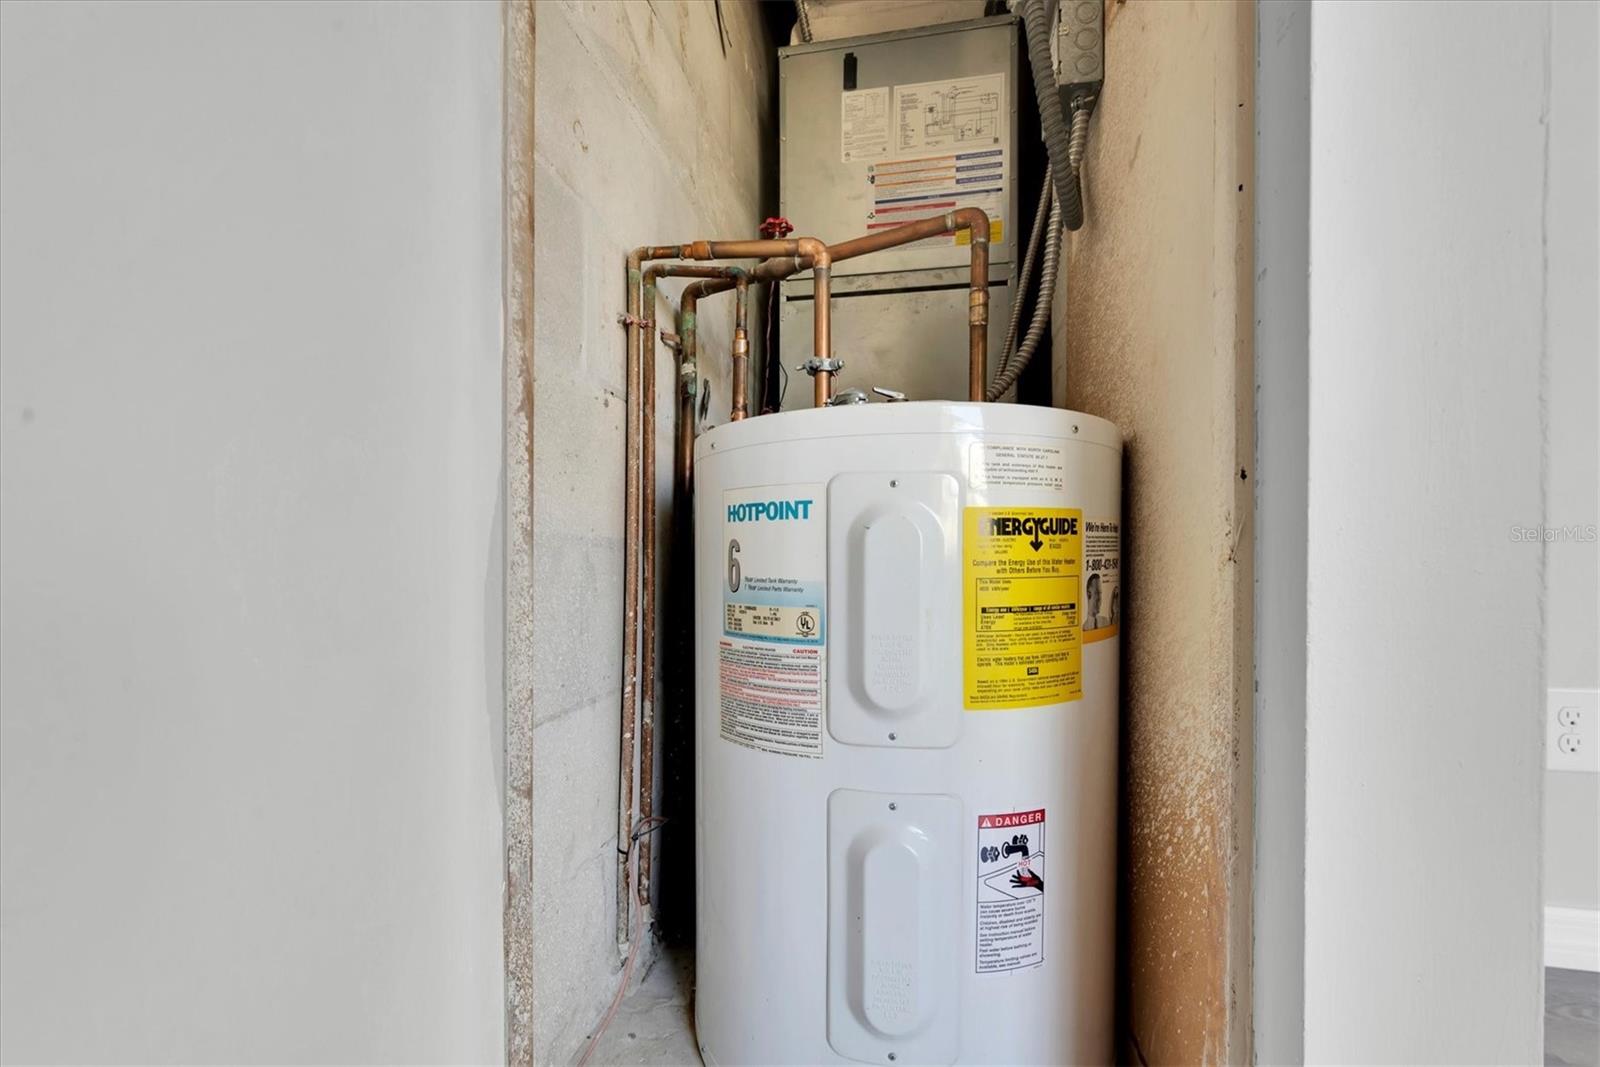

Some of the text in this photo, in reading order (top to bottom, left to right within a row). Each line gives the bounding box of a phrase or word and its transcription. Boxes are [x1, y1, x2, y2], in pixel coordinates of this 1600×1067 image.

[728, 500, 813, 522] HOTPOINT
[980, 517, 1078, 536] NERGYGUIDE
[728, 538, 741, 593] 6
[1008, 559, 1025, 567] Energy
[995, 812, 1042, 826] DANGER
